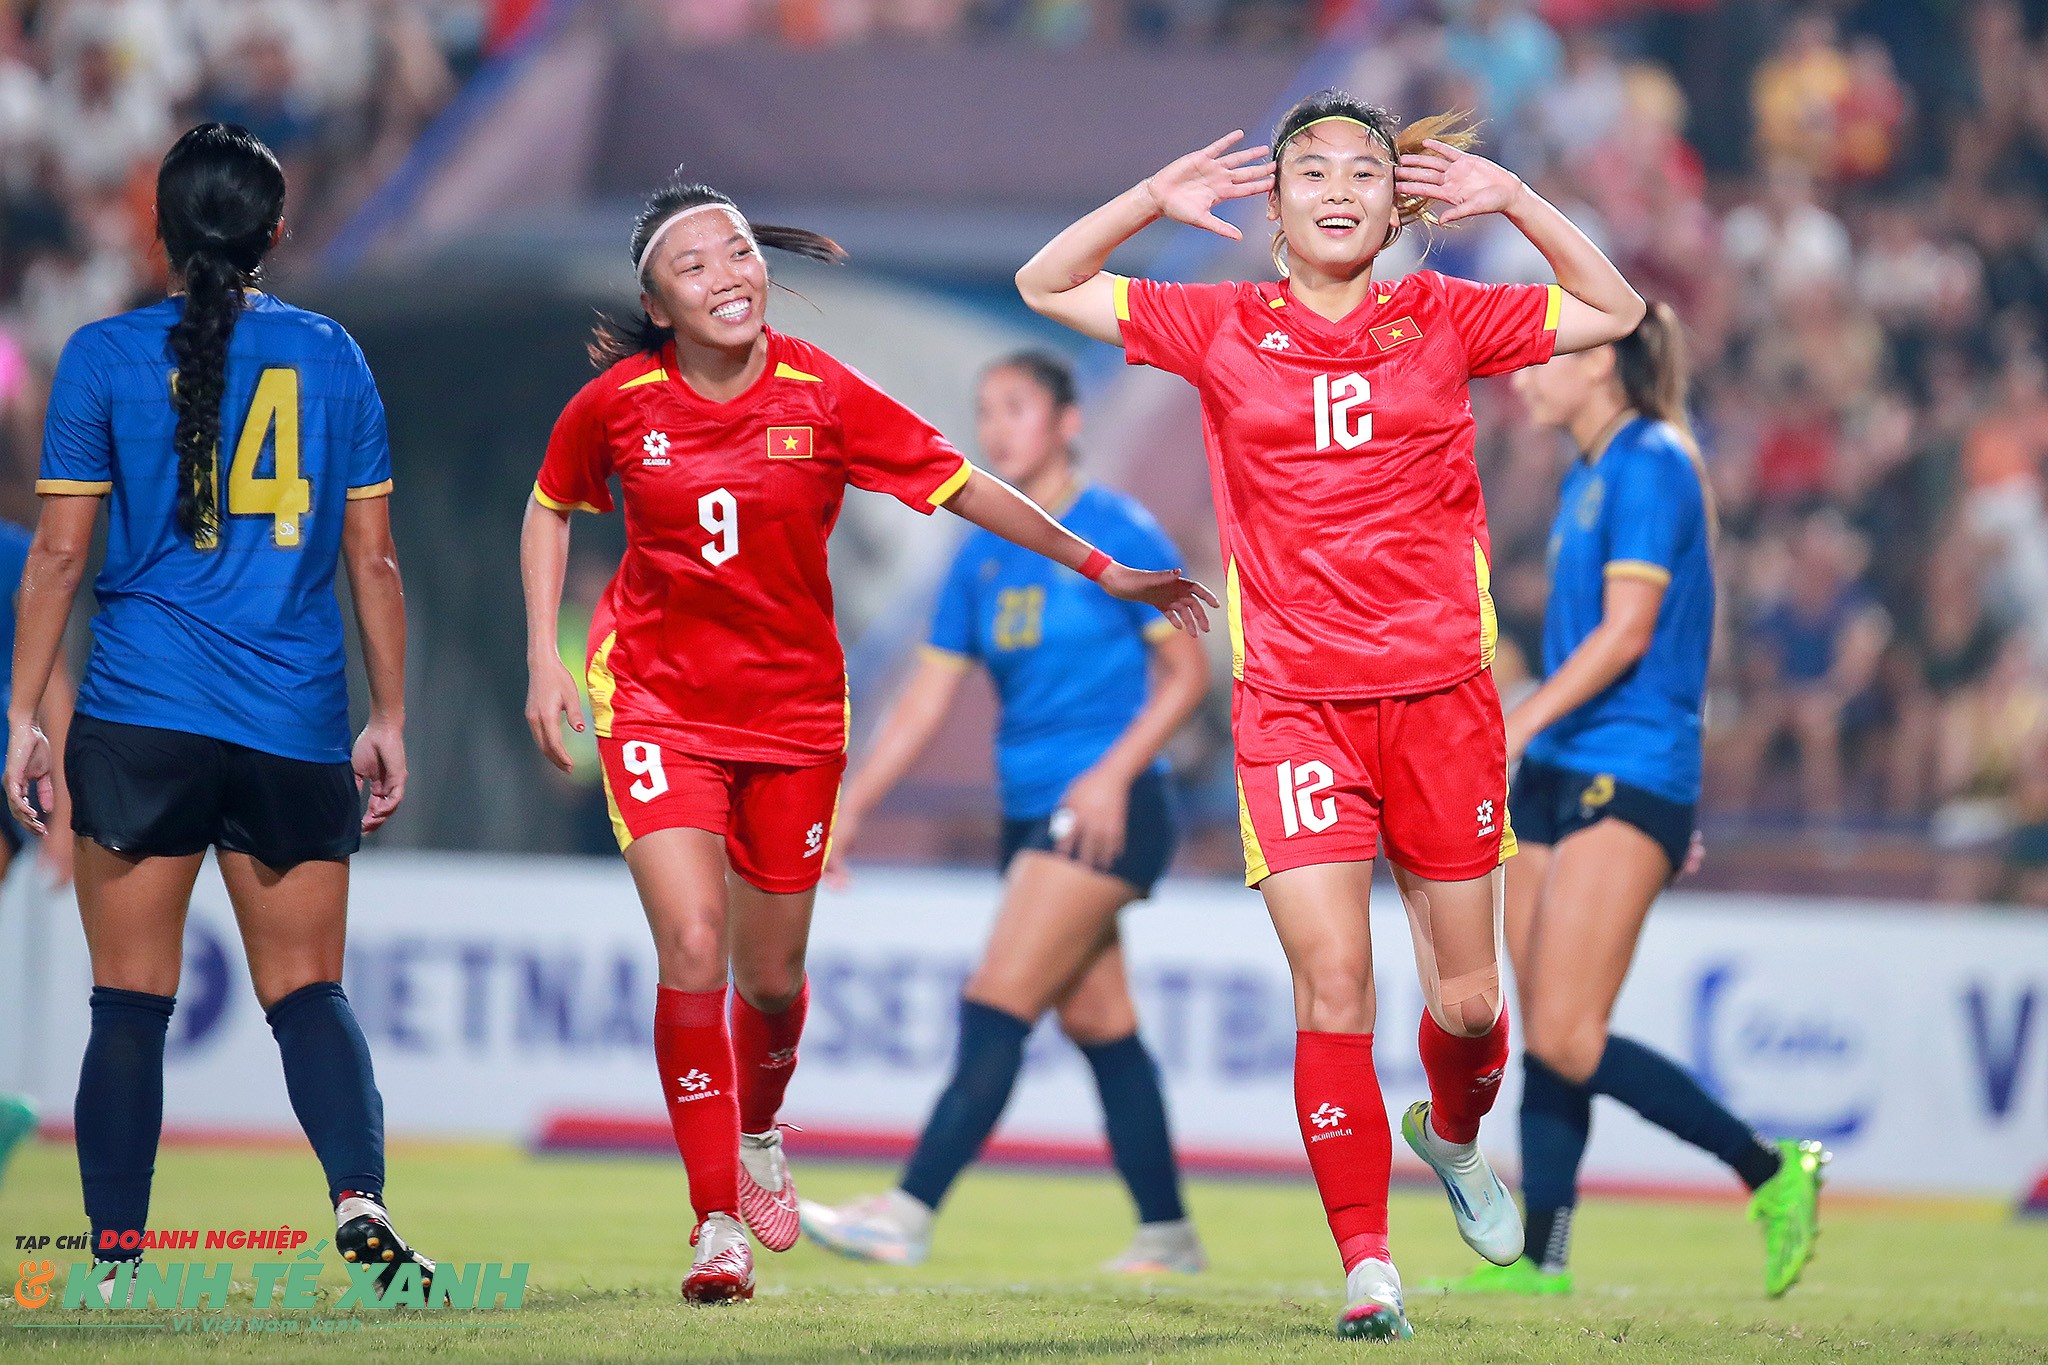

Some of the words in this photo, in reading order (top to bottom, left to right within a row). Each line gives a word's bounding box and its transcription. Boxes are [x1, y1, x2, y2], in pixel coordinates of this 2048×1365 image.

[1312, 371, 1373, 452] 12
[697, 487, 739, 567] 9
[621, 740, 669, 803] 9
[1276, 759, 1339, 839] 12
